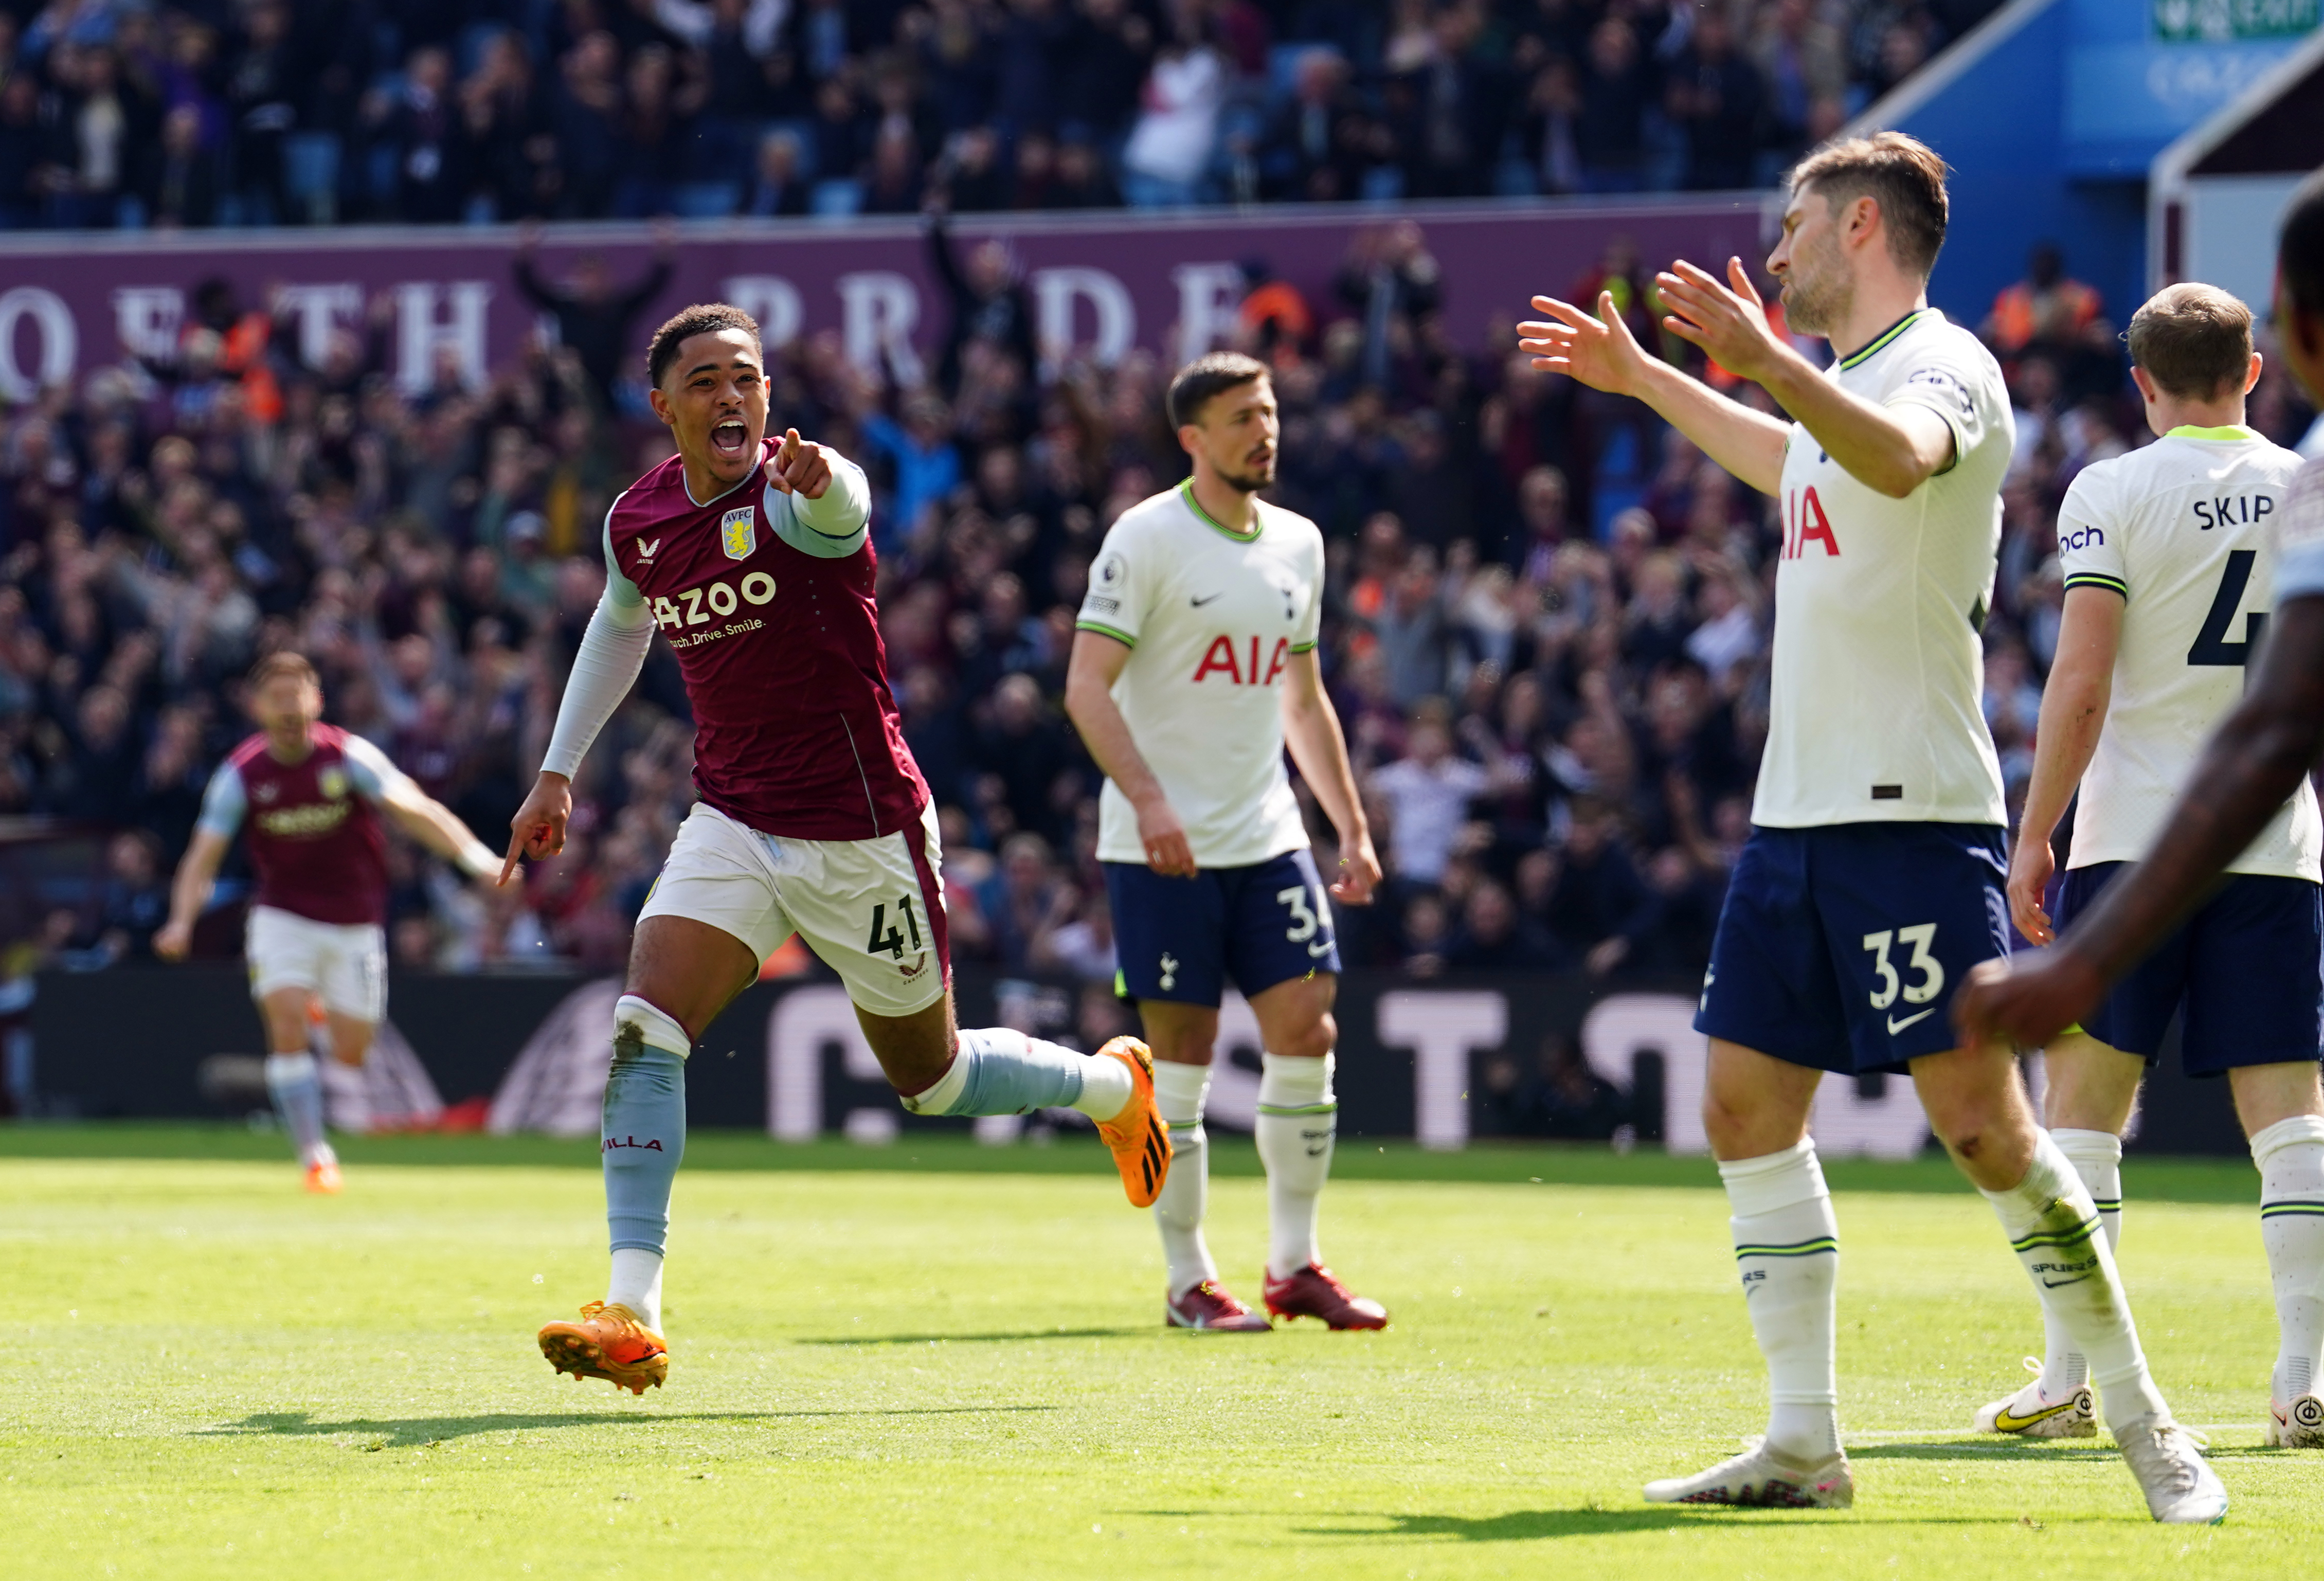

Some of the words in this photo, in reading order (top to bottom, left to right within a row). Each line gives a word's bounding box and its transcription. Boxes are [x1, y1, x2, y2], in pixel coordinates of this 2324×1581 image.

[724, 261, 1247, 389] PRDE
[725, 509, 751, 523] AVFC
[1780, 484, 1840, 560] IA
[2193, 495, 2275, 530] SKIP
[2059, 525, 2104, 559] nch
[668, 636, 692, 649] arch.
[691, 631, 726, 645] Drive.
[725, 619, 766, 635] Smile.
[2187, 549, 2272, 698] 4
[867, 893, 922, 960] 41
[1863, 923, 1945, 1010] 33
[2031, 1254, 2098, 1273] SPURS
